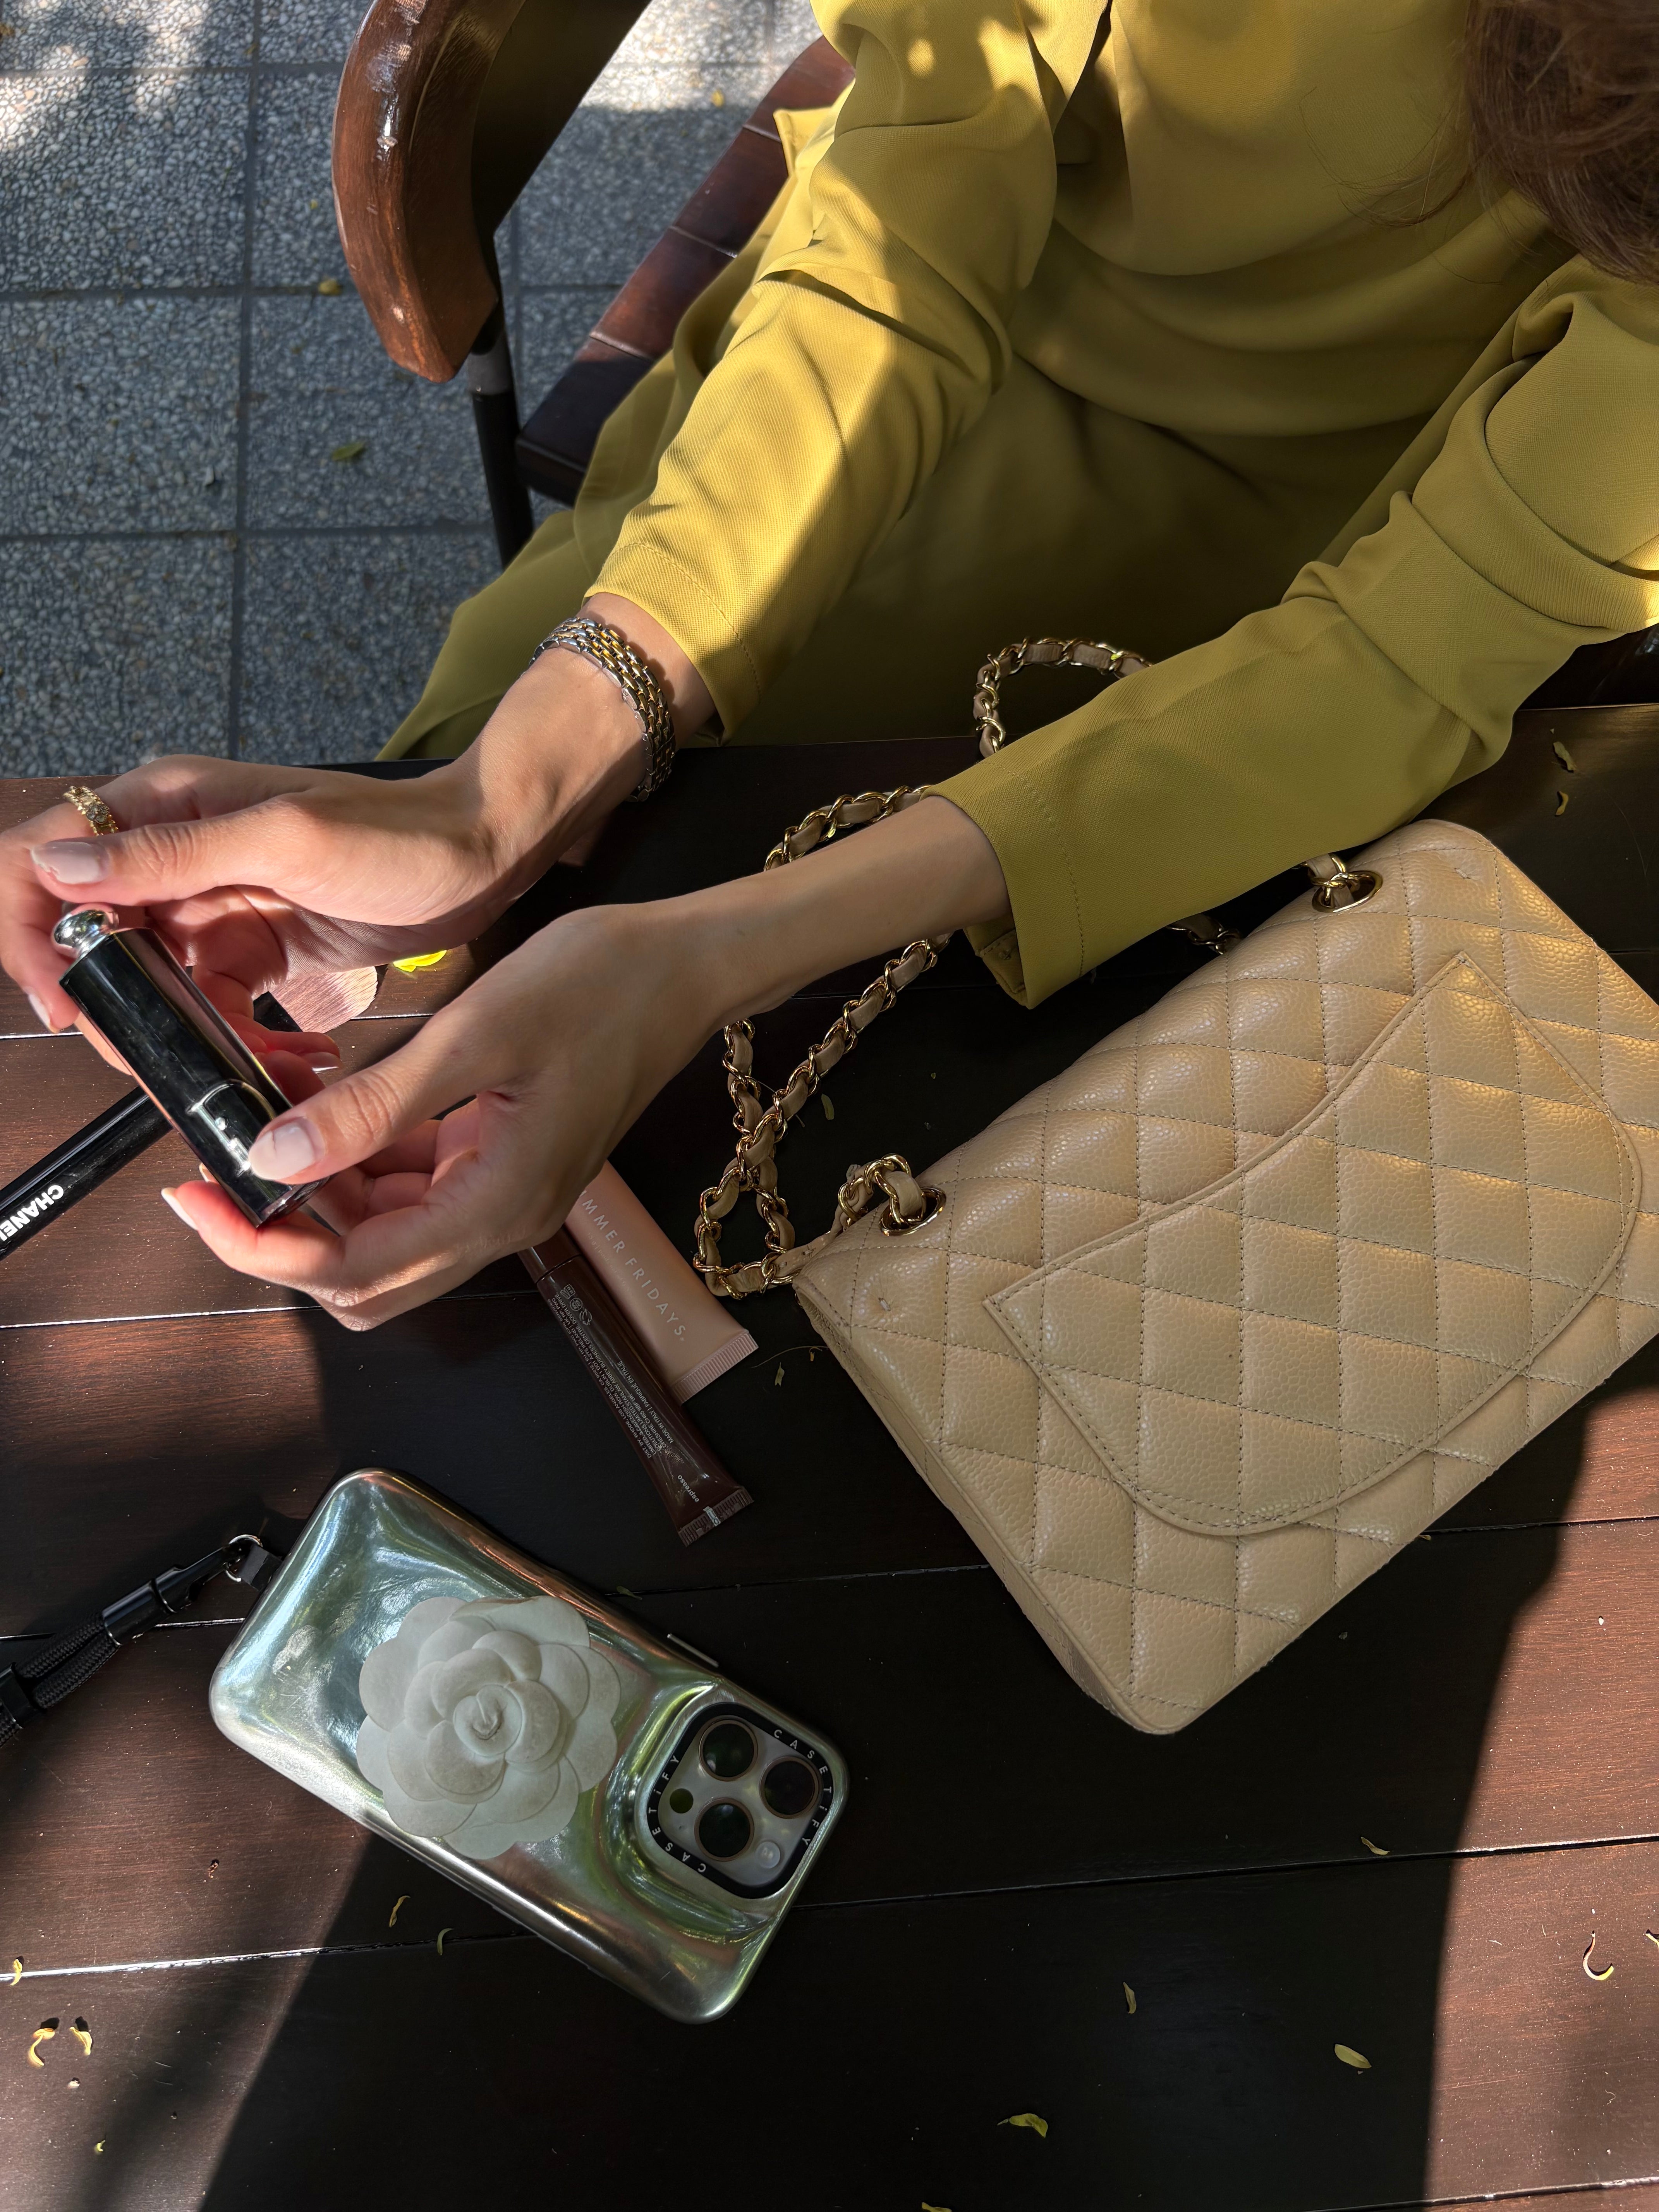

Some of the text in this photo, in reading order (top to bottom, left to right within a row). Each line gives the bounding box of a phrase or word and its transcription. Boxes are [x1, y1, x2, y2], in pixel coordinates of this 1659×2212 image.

[580, 1190, 625, 1253] MMER
[649, 1410, 660, 1423] ITALY
[662, 1428, 673, 1443] MADE
[677, 1474, 700, 1503] espresso
